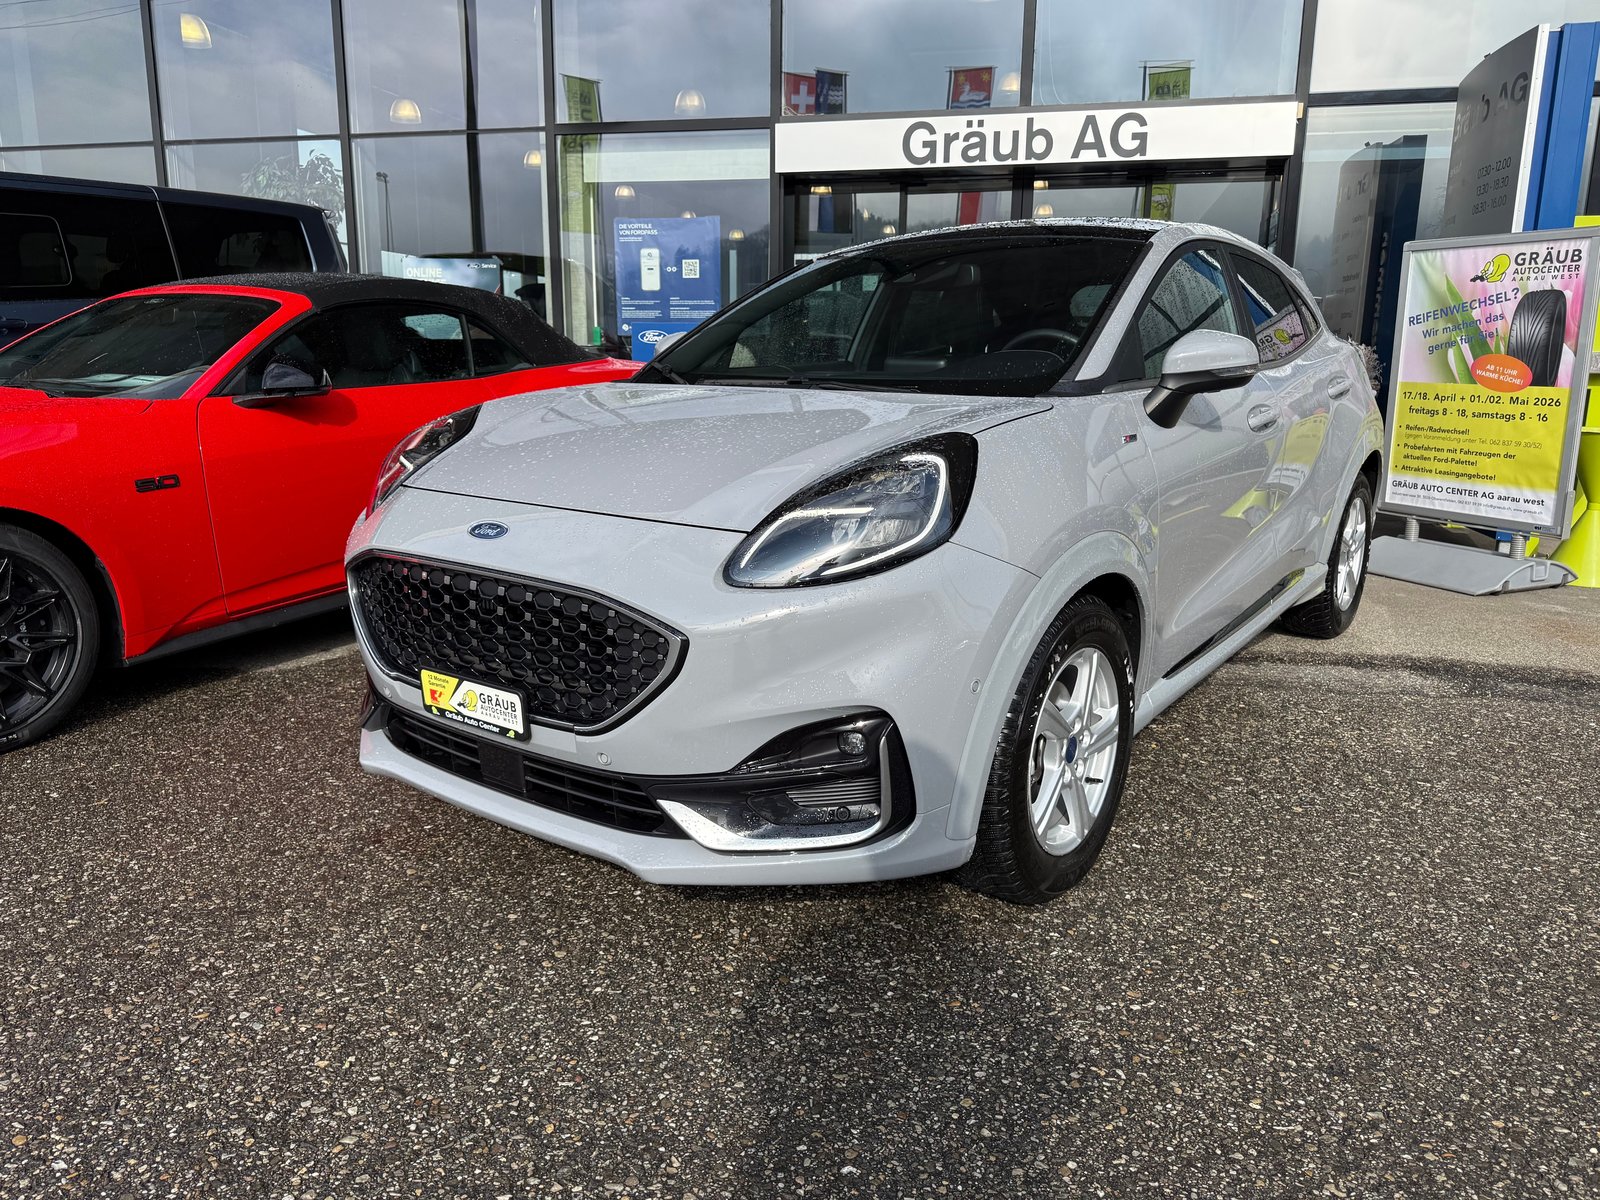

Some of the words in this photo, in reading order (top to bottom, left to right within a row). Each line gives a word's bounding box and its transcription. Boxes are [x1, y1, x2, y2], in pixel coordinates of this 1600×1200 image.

[1498, 71, 1529, 112] AG
[902, 117, 1054, 166] Gräub
[1070, 112, 1148, 159] AG
[1514, 247, 1583, 267] GRÄUB
[407, 267, 442, 277] ONLINE
[1512, 264, 1581, 275] AUTOCENTER
[1408, 287, 1520, 326] REIFENWECHSEL?
[1422, 327, 1438, 339] Wir
[1442, 317, 1481, 335] machen
[1485, 312, 1504, 324] das
[643, 332, 664, 341] Ford
[1428, 340, 1456, 355] gerne
[1459, 332, 1475, 345] für
[1479, 329, 1499, 341] Sie!
[1476, 368, 1499, 380] WARME
[1499, 373, 1524, 385] KÜCHE!
[1497, 365, 1503, 373] 11
[1504, 367, 1518, 376] UHR
[1402, 391, 1430, 401] 17./18.
[1433, 393, 1456, 404] April
[1470, 394, 1504, 405] 01./02.
[1509, 396, 1529, 406] Mai
[1533, 397, 1561, 407] 2026
[1408, 405, 1440, 417] freitags
[1442, 408, 1447, 416] 8
[1456, 409, 1468, 419] 18,
[1471, 411, 1516, 422] samstags
[1519, 412, 1526, 421] 8
[1536, 413, 1548, 422] 16
[1405, 424, 1470, 435] Reifen-/Radwechsel!
[1405, 432, 1422, 440] (gegen
[1423, 433, 1461, 444] Voranmeldung
[1502, 439, 1512, 447] 837
[1523, 441, 1542, 450] 30/52)
[1403, 443, 1445, 453] Probefahrten
[1460, 449, 1501, 459] Fahrzeugen
[1503, 451, 1516, 460] der
[1403, 453, 1432, 461] aktuellen
[1433, 456, 1478, 467] Ford-Palette!
[1401, 465, 1433, 474] Attraktive
[1434, 468, 1496, 481] Leasingangebote!
[134, 474, 180, 493] 5.0
[1392, 480, 1418, 490] GRÄUB
[1420, 484, 1444, 493] AUTO
[1445, 487, 1479, 498] CENTER
[1481, 491, 1495, 499] AG
[1497, 494, 1521, 503] aarau
[1523, 497, 1545, 506] west
[474, 524, 501, 536] Ford
[434, 676, 449, 684] Monate
[479, 693, 517, 713] GRÄUB
[480, 704, 518, 720] AUTOCENTER
[480, 711, 500, 720] AARAU
[503, 717, 518, 726] WEST
[445, 711, 464, 722] Gräub
[464, 717, 478, 727] Auto
[479, 722, 500, 733] Center
